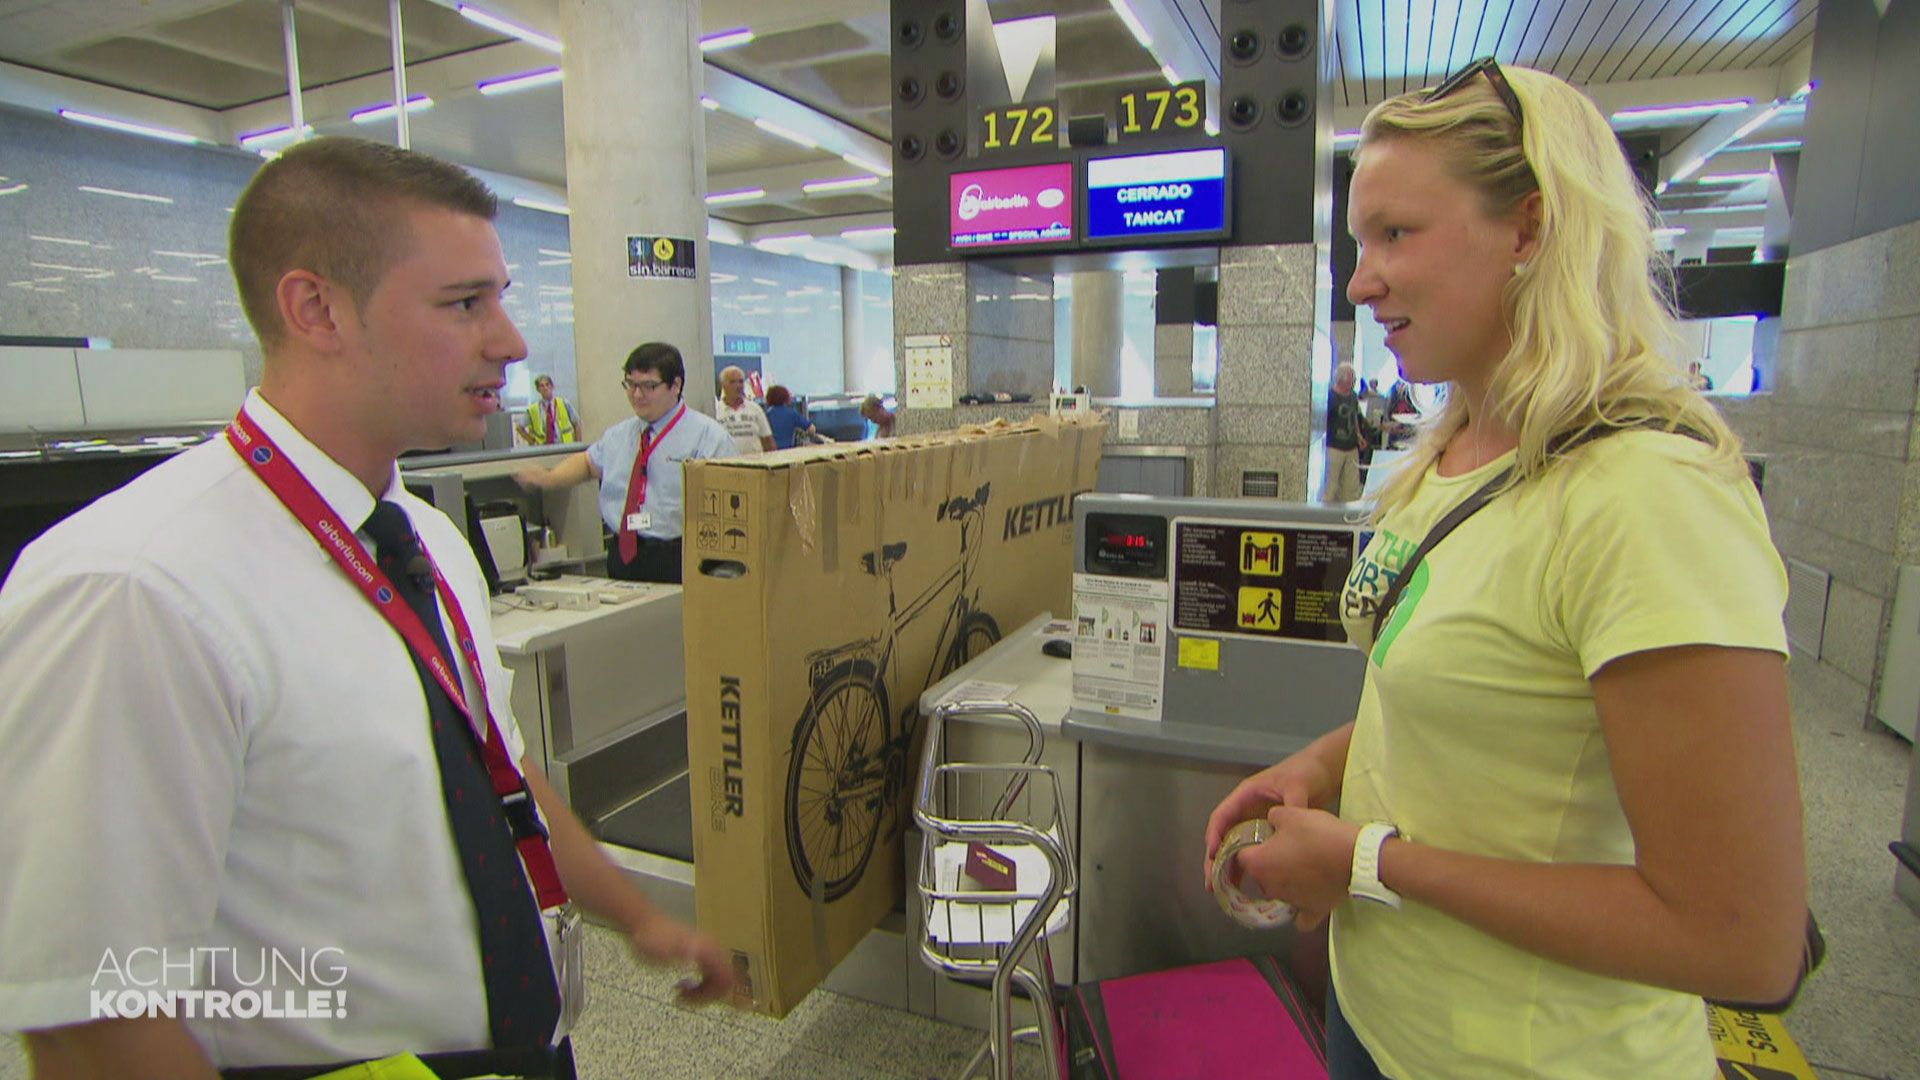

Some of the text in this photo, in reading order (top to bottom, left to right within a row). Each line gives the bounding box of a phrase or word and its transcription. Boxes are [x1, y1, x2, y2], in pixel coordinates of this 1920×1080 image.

[984, 106, 1054, 148] 172
[1121, 88, 1200, 133] 173
[1116, 184, 1193, 203] CERRADO
[1123, 209, 1186, 227] TANCAT
[629, 262, 695, 278] sin barreras
[1002, 489, 1092, 542] KETTL
[318, 519, 375, 584] airberlin.com
[720, 675, 745, 818] KETTLER
